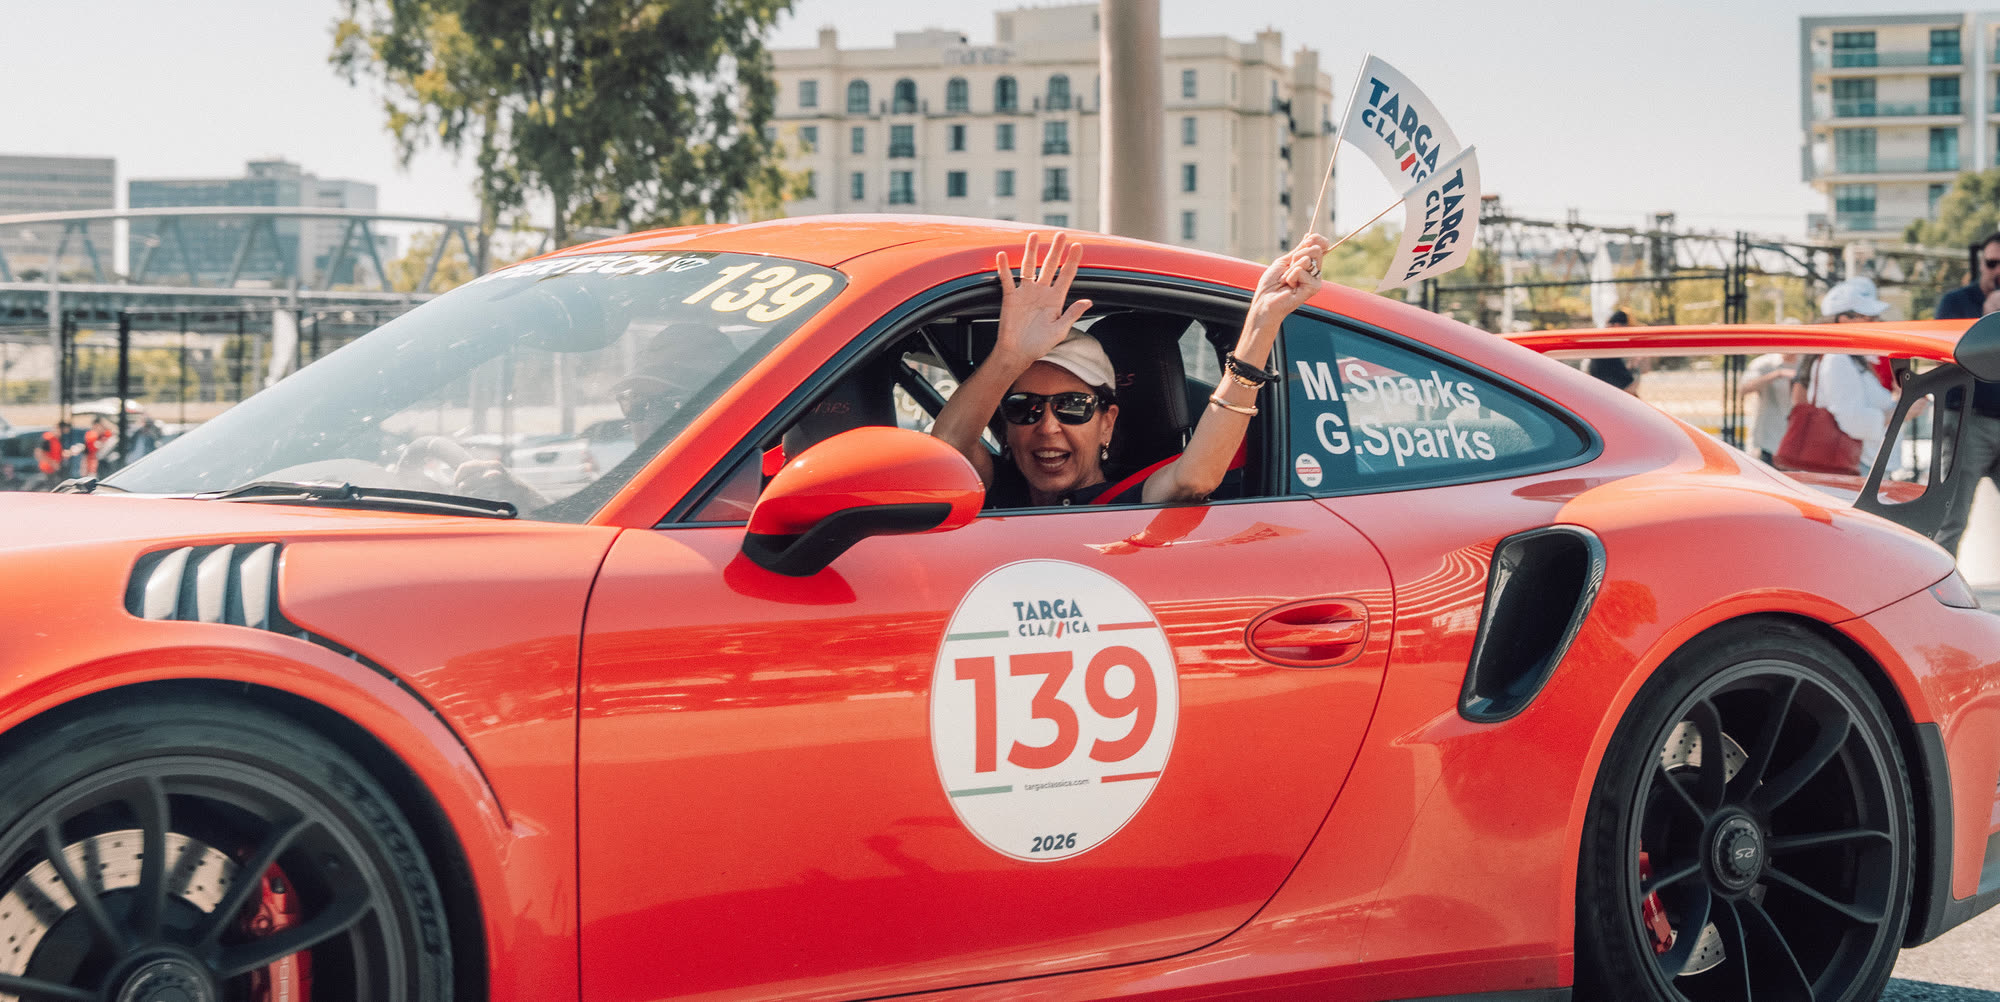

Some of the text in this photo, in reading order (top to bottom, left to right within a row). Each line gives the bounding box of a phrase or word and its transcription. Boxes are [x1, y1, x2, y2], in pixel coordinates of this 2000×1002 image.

[1361, 108, 1427, 183] CLASSIC
[1369, 76, 1441, 174] TARGA
[1425, 167, 1465, 270] TARGA
[681, 261, 835, 323] 139
[1295, 360, 1481, 415] M.Sparks
[1315, 411, 1497, 467] G.Sparks
[1013, 598, 1083, 622] TARGA
[954, 645, 1158, 774] 139
[1024, 778, 1090, 792] targaclassica.com
[1030, 832, 1078, 853] 2026
